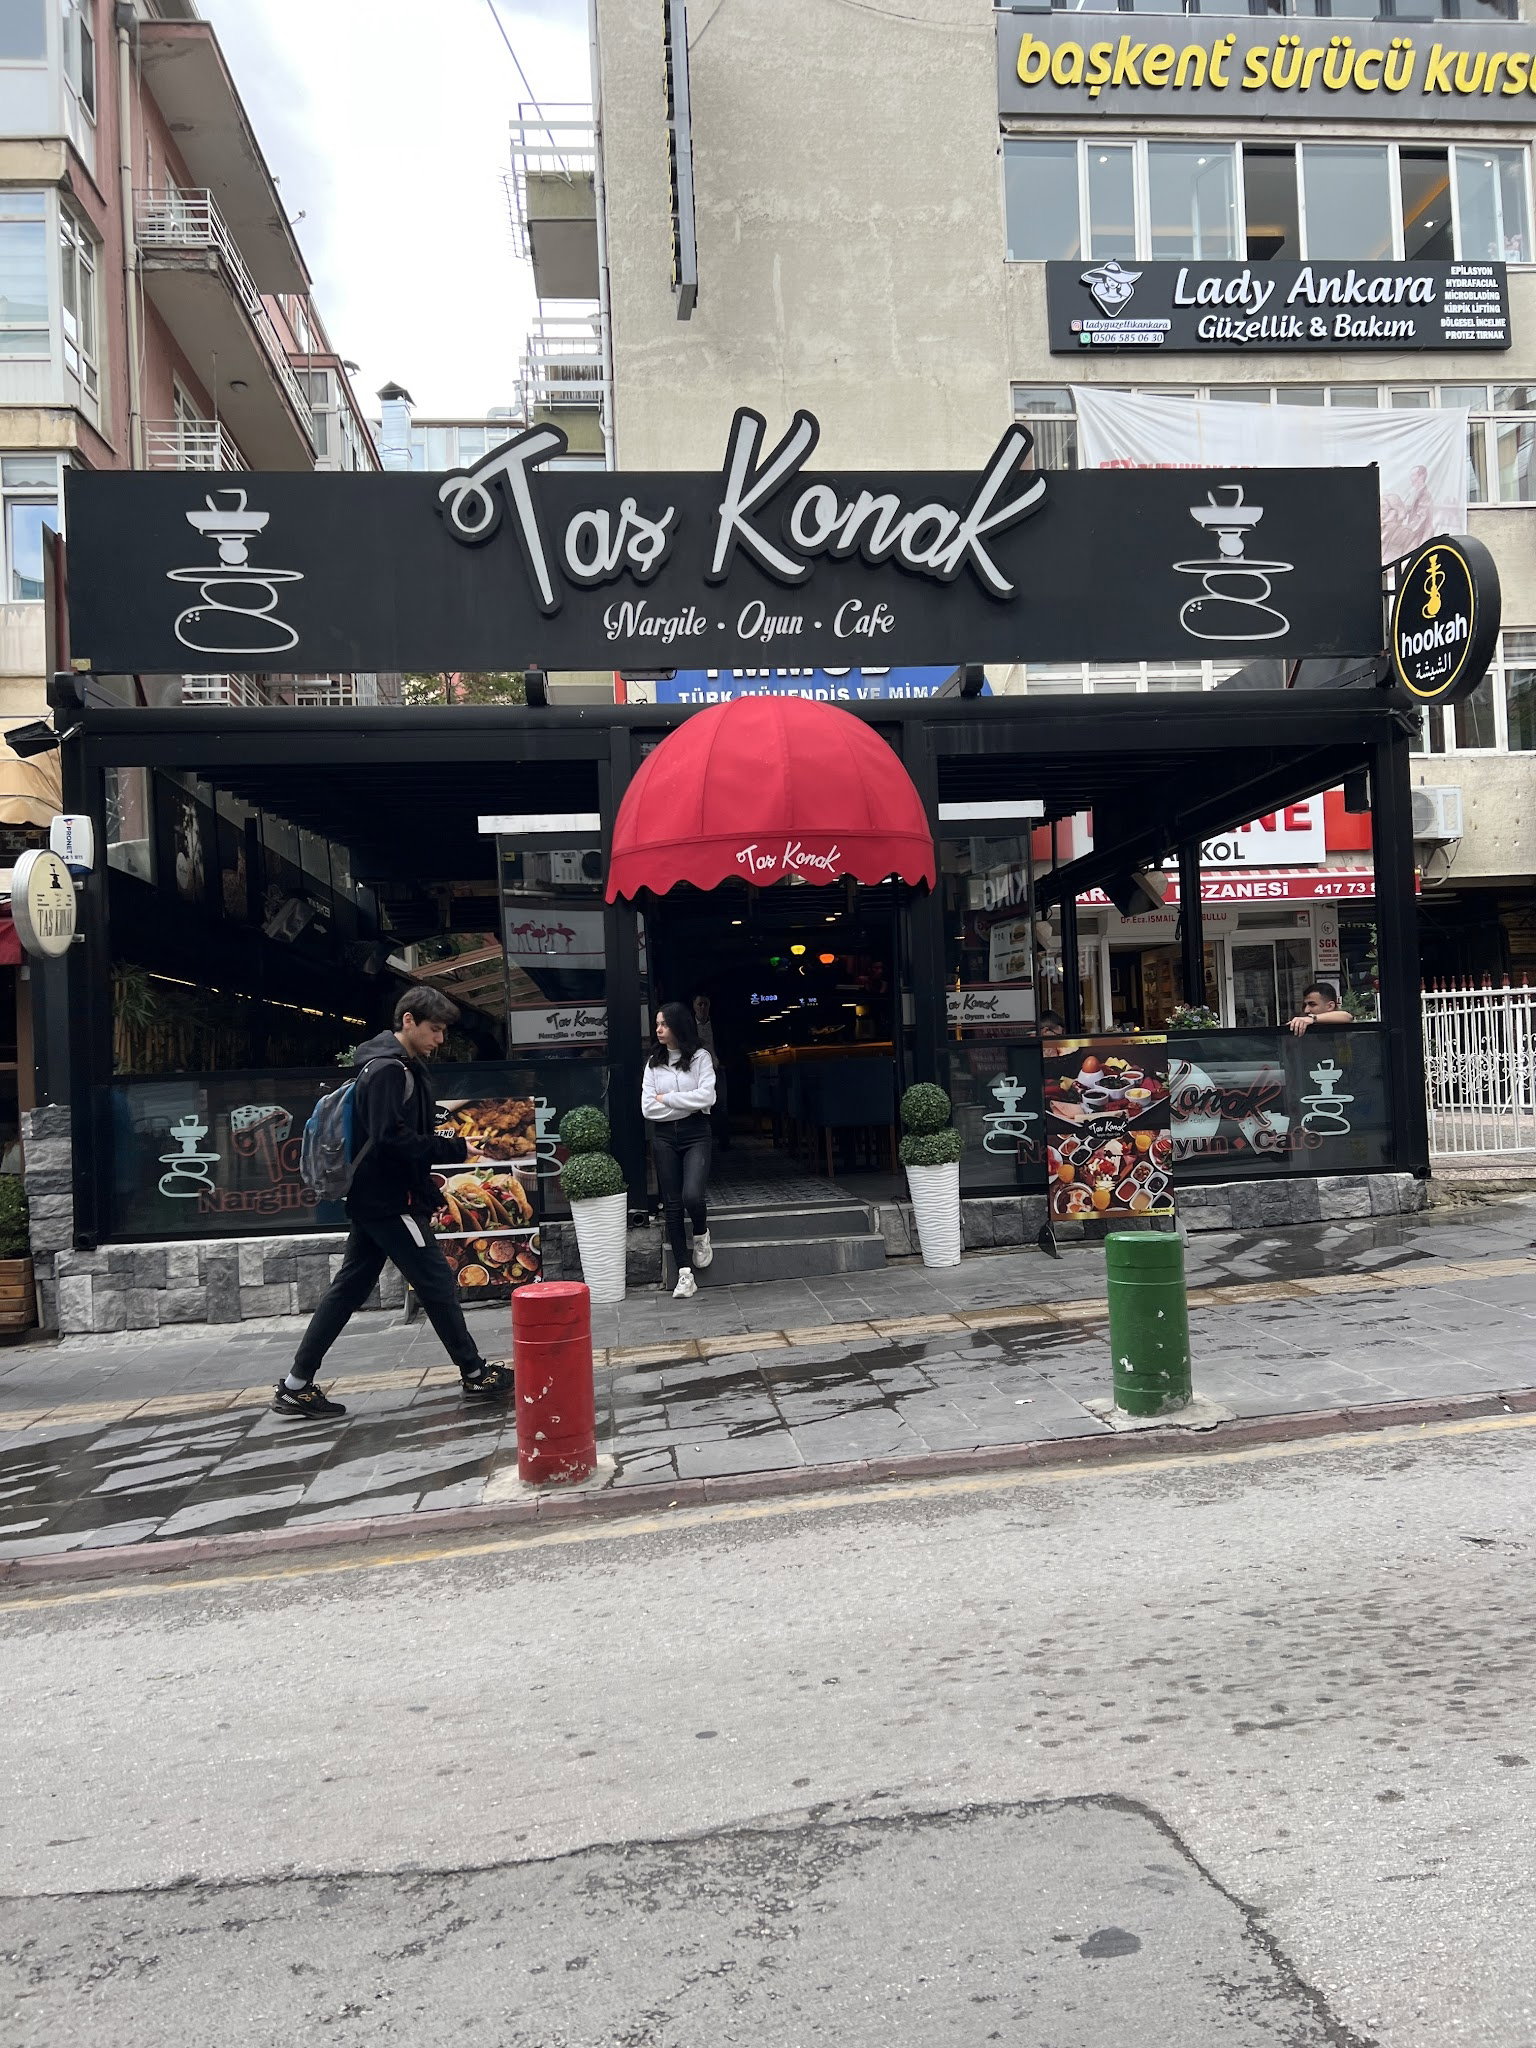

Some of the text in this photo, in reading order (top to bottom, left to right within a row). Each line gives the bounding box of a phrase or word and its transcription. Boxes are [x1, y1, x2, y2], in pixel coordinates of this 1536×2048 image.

[1016, 32, 1536, 98] başkent sürücü kurs
[1174, 266, 1436, 315] Lady Ankara
[1093, 333, 1163, 342] 0506 585 06 30
[1198, 314, 1416, 342] Güzellik & Bakım
[438, 414, 1047, 605] Taş Konak
[603, 599, 896, 643] Nargile Oyun Cafe
[1401, 613, 1468, 658] hookah
[1415, 652, 1452, 681] الشيشة
[678, 688, 733, 704] TÜRK
[857, 687, 882, 700] VE
[782, 841, 841, 873] Konak
[1175, 882, 1289, 900] ZANESİ
[1314, 884, 1343, 895] 417
[1347, 883, 1366, 894] 73
[1319, 939, 1338, 948] SGK
[1172, 1135, 1229, 1156] yun
[199, 1183, 321, 1214] Nargile
